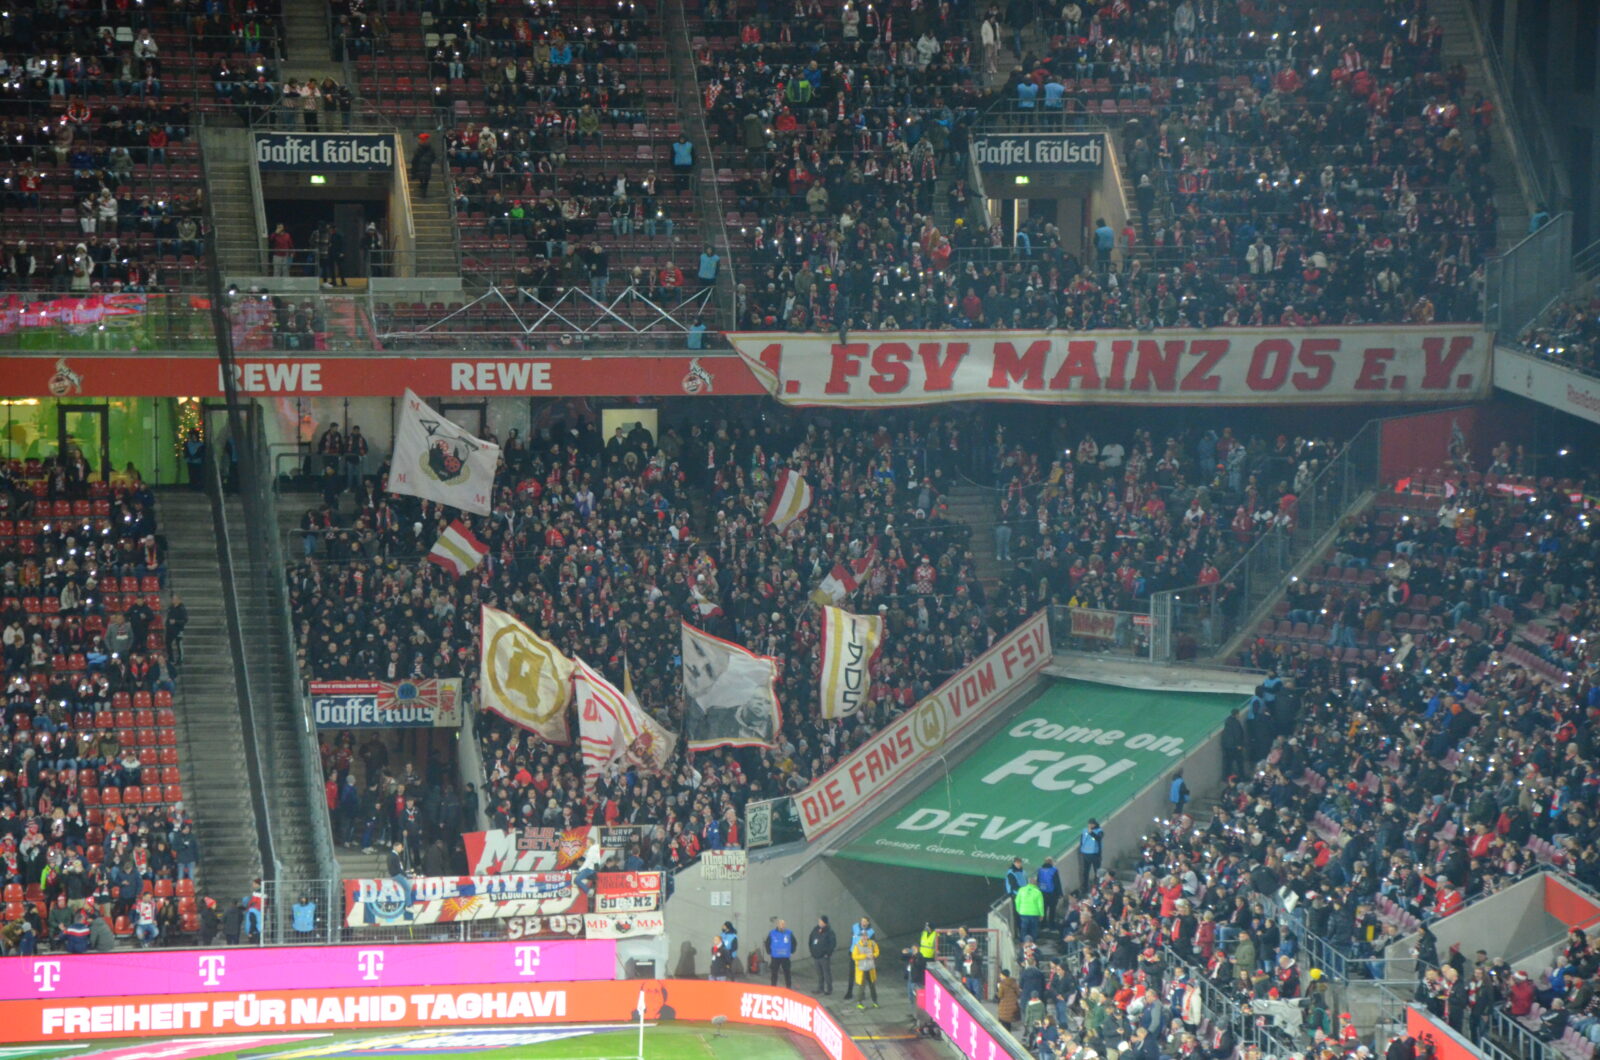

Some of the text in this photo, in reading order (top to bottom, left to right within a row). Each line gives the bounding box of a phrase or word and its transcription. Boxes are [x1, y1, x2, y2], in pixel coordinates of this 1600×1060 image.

[256, 137, 392, 167] Gaffel Kölsch
[974, 139, 1103, 165] Gaffel Kölsch
[218, 363, 323, 391] REWE
[451, 362, 553, 391] REWE
[824, 342, 971, 395] FSV
[988, 339, 1230, 391] MAINZ
[802, 623, 1046, 827] DIE FANS VOM FSV
[1008, 717, 1185, 757] Come on,
[981, 749, 1138, 795] FC!
[896, 808, 1072, 848] DEVK
[471, 874, 539, 895] VIVE
[42, 990, 566, 1034] FREIHEIT FÜR NAHID TAGHAVI
